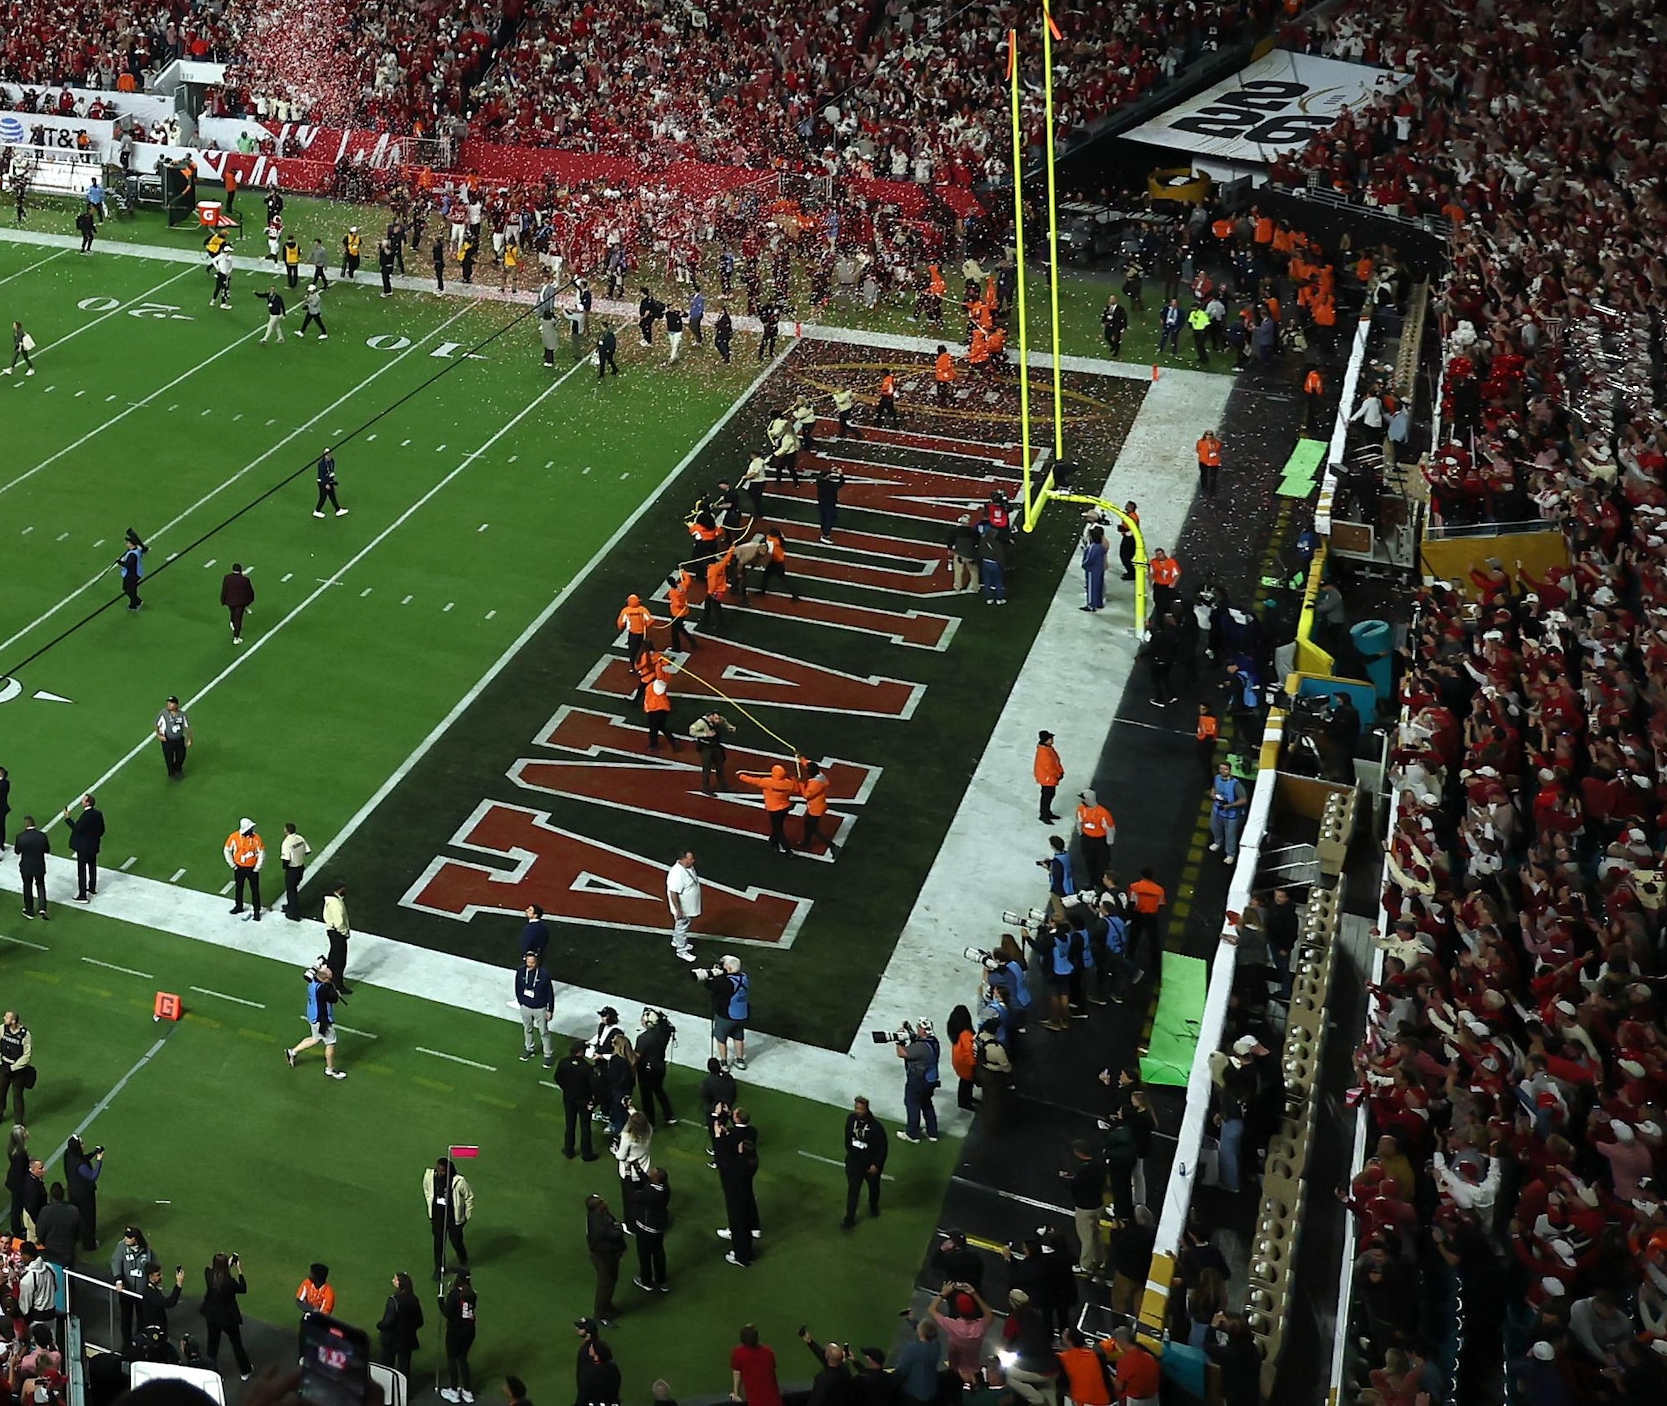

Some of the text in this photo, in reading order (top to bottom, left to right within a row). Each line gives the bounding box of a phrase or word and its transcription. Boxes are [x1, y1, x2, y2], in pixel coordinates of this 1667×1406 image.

[203, 210, 214, 221] G
[77, 296, 174, 320] 20
[365, 334, 474, 359] 10
[398, 414, 1053, 951] INDIANA
[160, 995, 175, 1016] G
